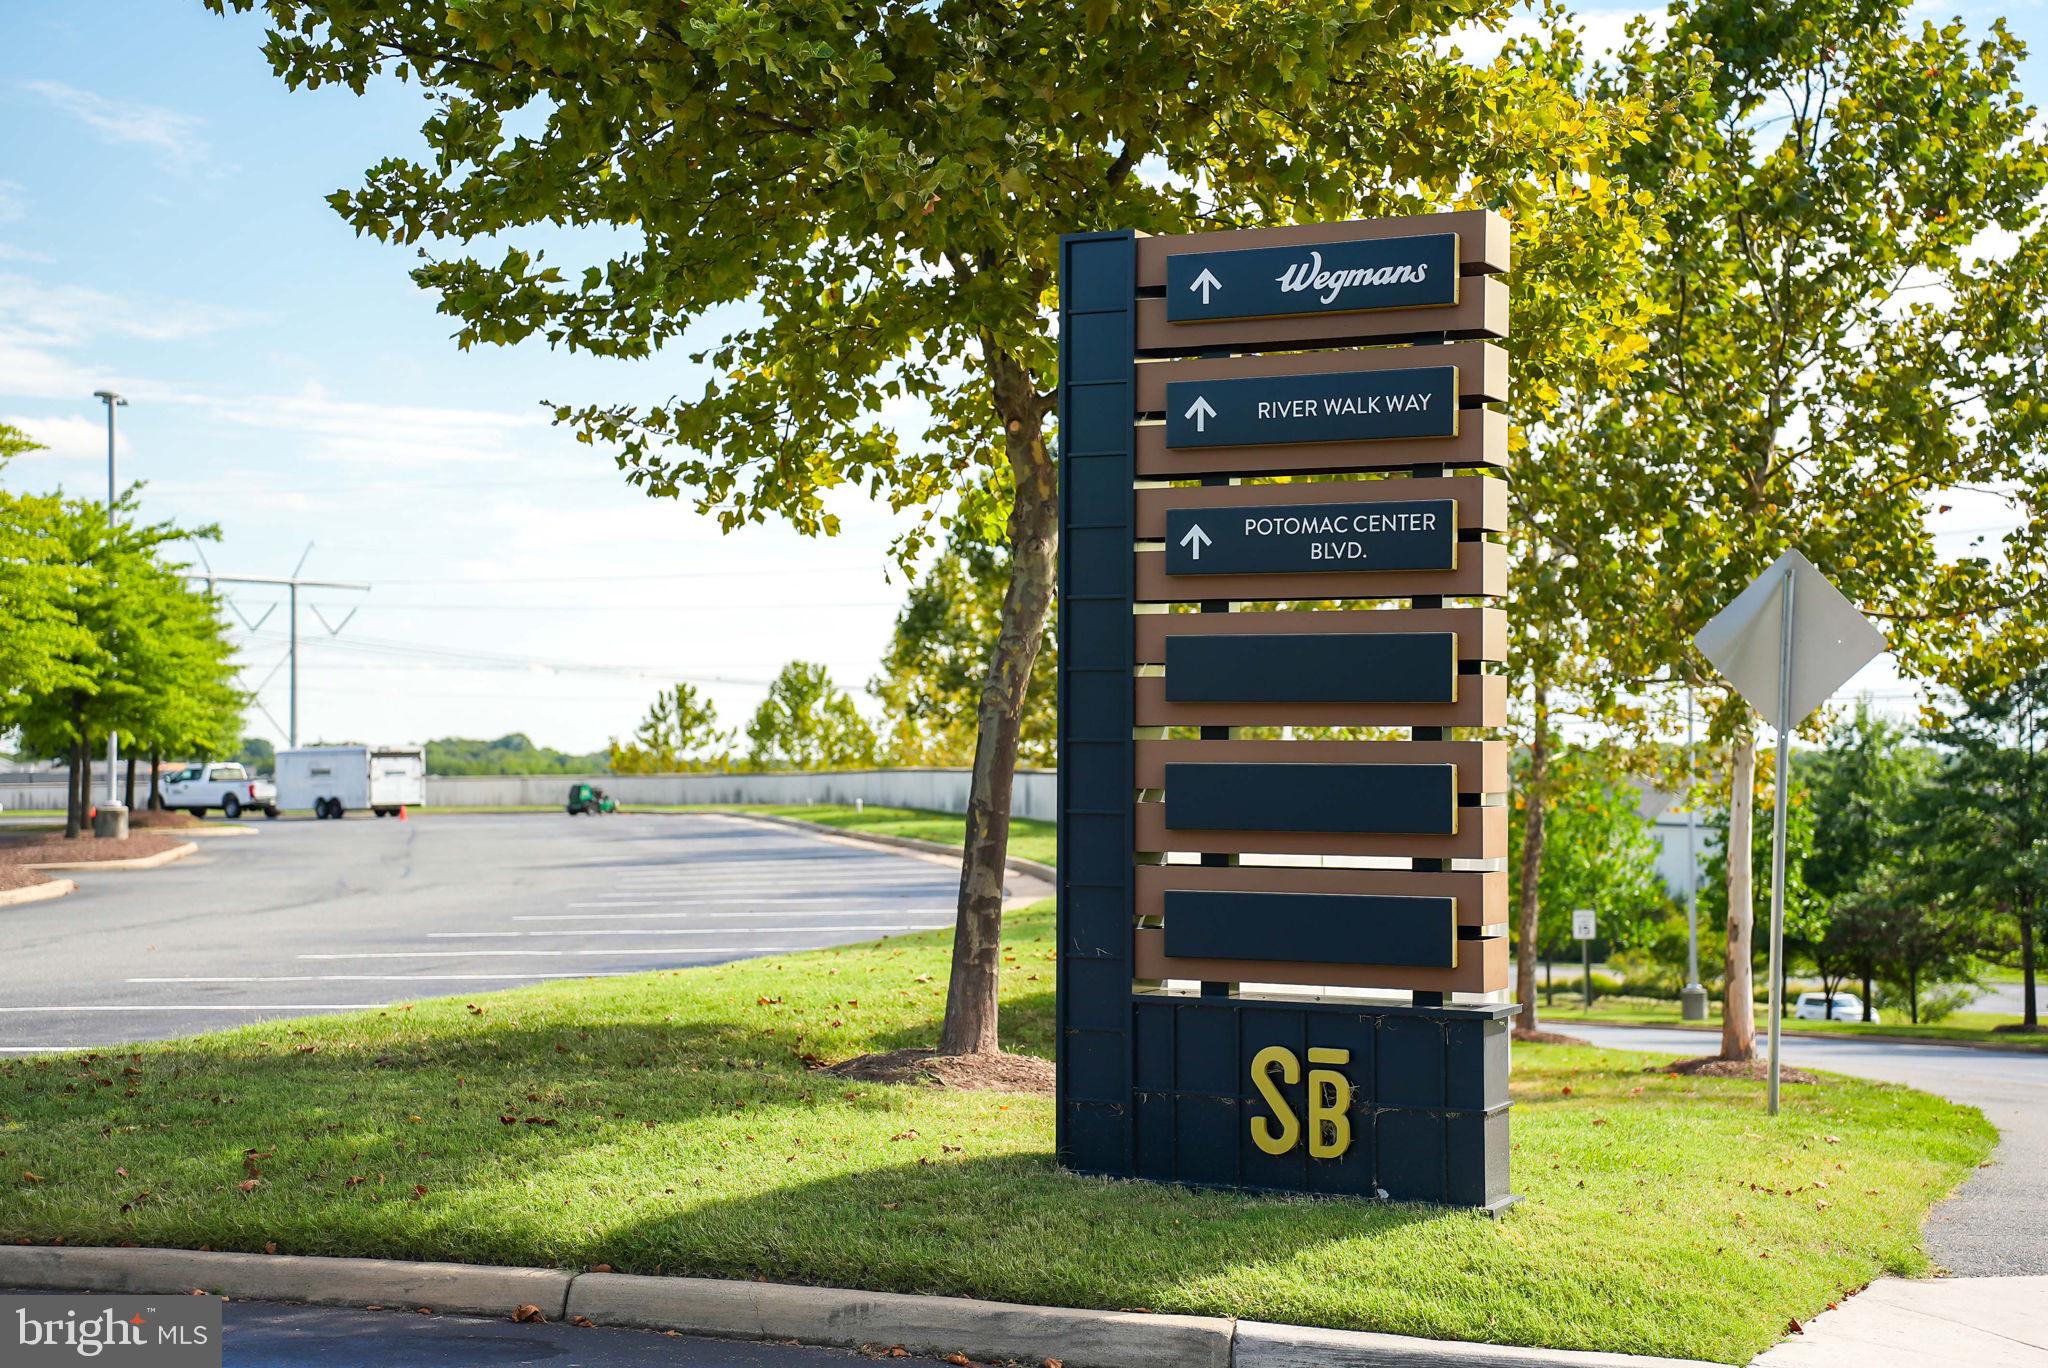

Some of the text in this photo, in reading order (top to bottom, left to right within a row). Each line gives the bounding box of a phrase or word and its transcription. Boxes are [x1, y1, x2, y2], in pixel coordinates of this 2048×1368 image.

[1275, 251, 1428, 304] Wegmans
[1258, 393, 1432, 419] RIVER WALK WAY
[1245, 513, 1436, 535] POTOMAC CENTER
[1310, 541, 1367, 560] BLVD.
